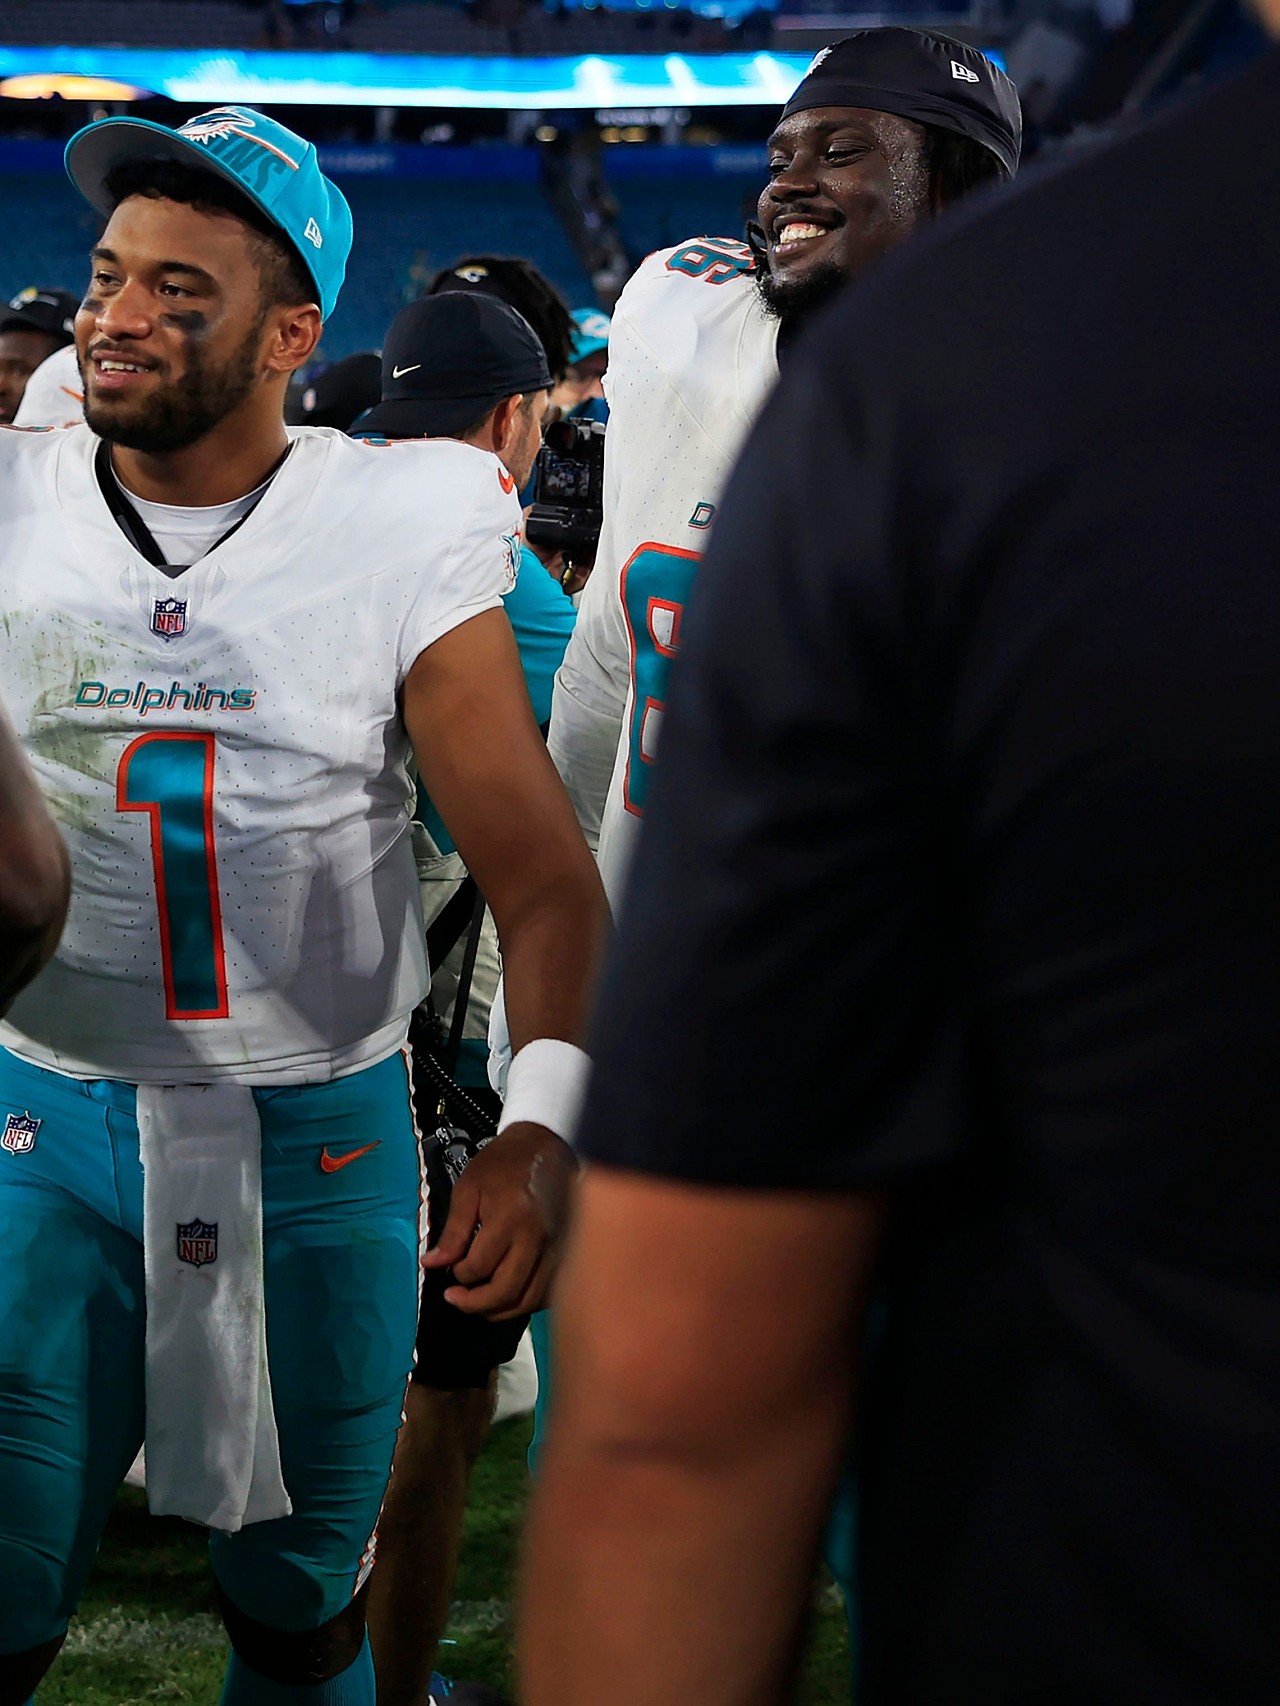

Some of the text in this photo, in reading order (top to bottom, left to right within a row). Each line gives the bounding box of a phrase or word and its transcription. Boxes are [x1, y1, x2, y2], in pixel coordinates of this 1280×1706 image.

[155, 613, 184, 633] NFL
[75, 680, 257, 717] Dolphins
[115, 731, 230, 1020] 1
[6, 1129, 31, 1149] NFL
[180, 1239, 215, 1263] NFL
